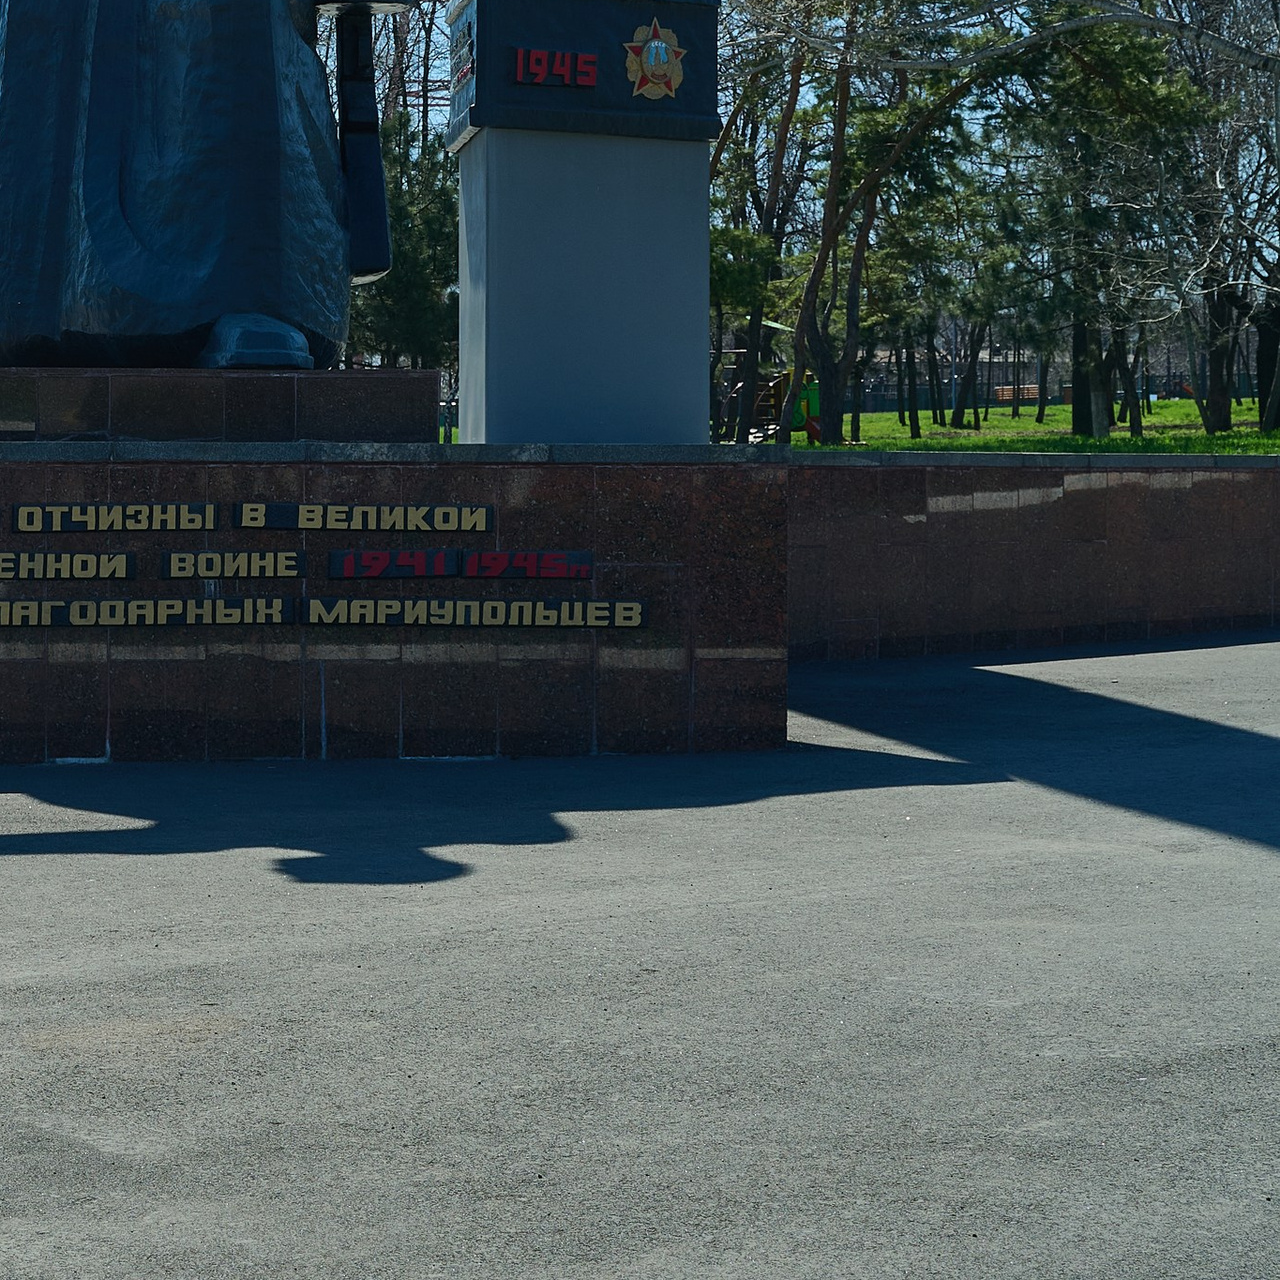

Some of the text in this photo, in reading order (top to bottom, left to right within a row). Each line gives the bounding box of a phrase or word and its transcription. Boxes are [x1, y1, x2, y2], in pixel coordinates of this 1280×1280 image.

[517, 50, 596, 85] 1945
[19, 506, 213, 531] ОТЧИЗНЫ
[243, 504, 265, 526] В
[344, 552, 444, 577] 1941
[311, 601, 640, 625] МАРИУПОЛЬЦЕВ
